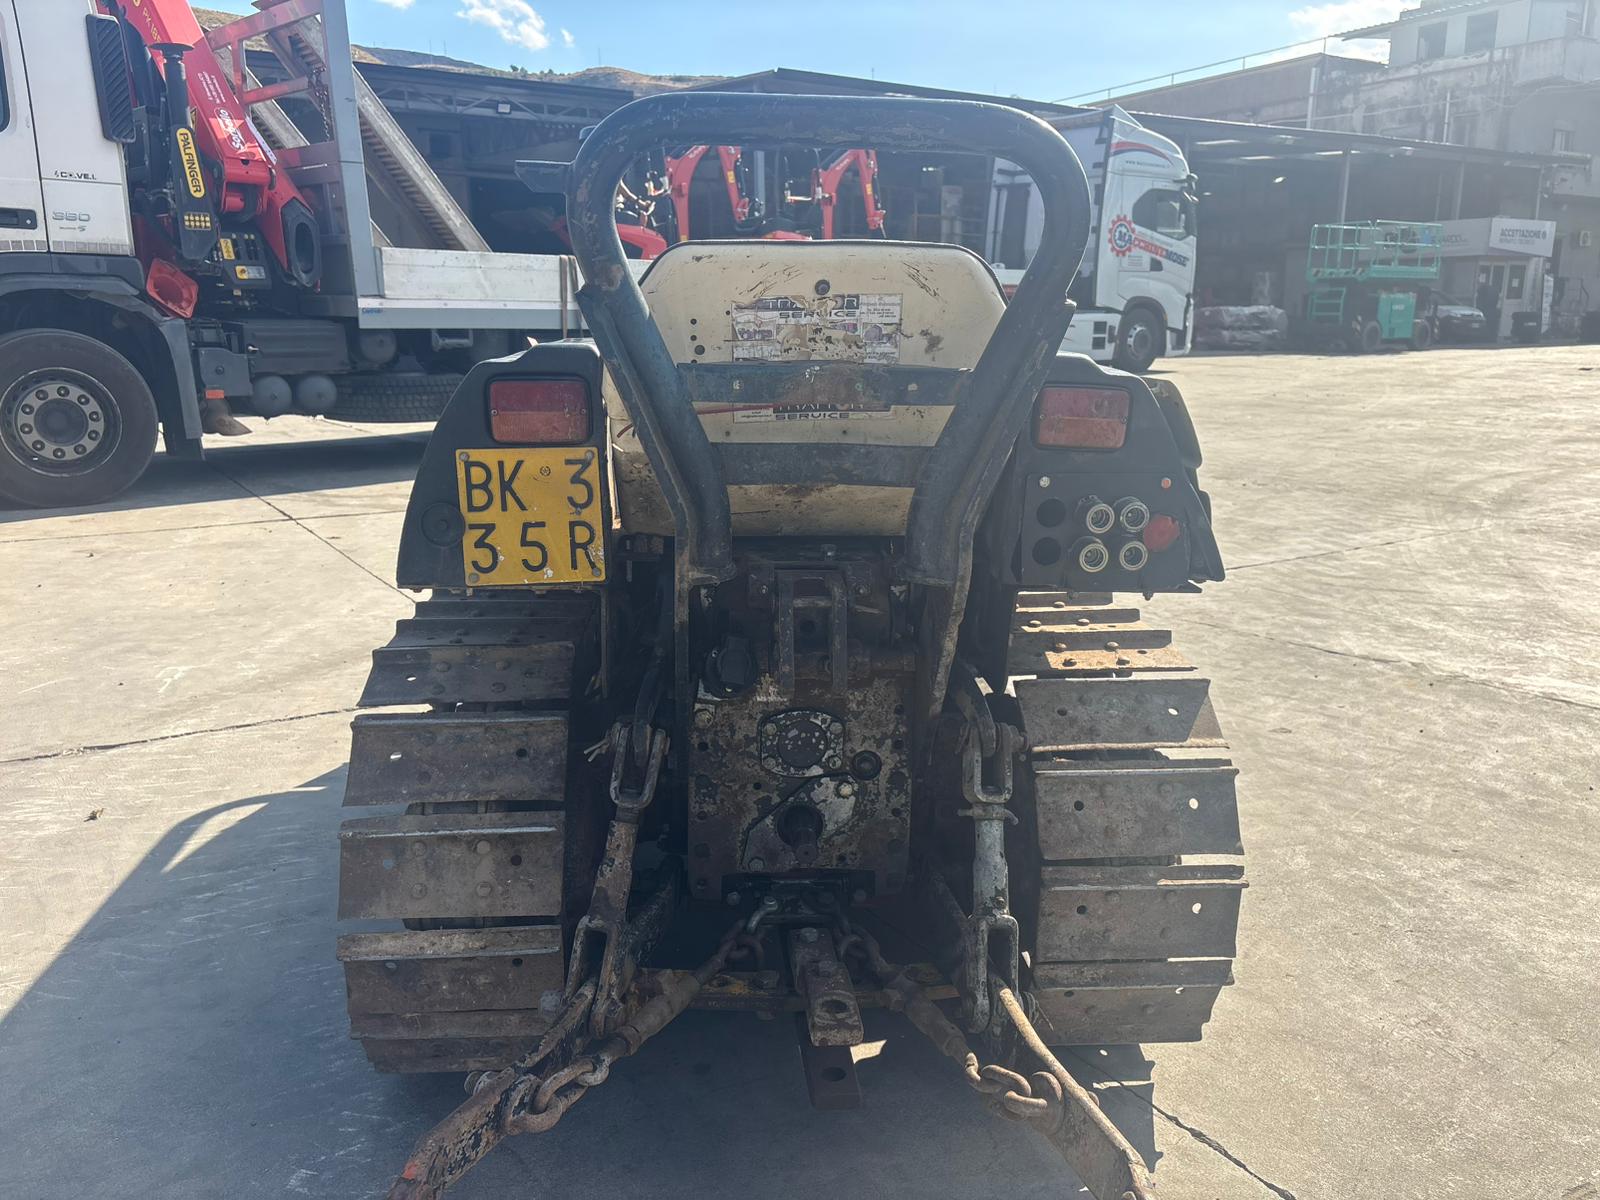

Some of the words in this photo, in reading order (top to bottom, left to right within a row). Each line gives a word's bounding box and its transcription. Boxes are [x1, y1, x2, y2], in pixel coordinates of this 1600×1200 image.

[179, 132, 202, 193] PALFINGER
[775, 411, 850, 421] SERVICE
[463, 459, 528, 513] BK
[564, 458, 594, 511] 3
